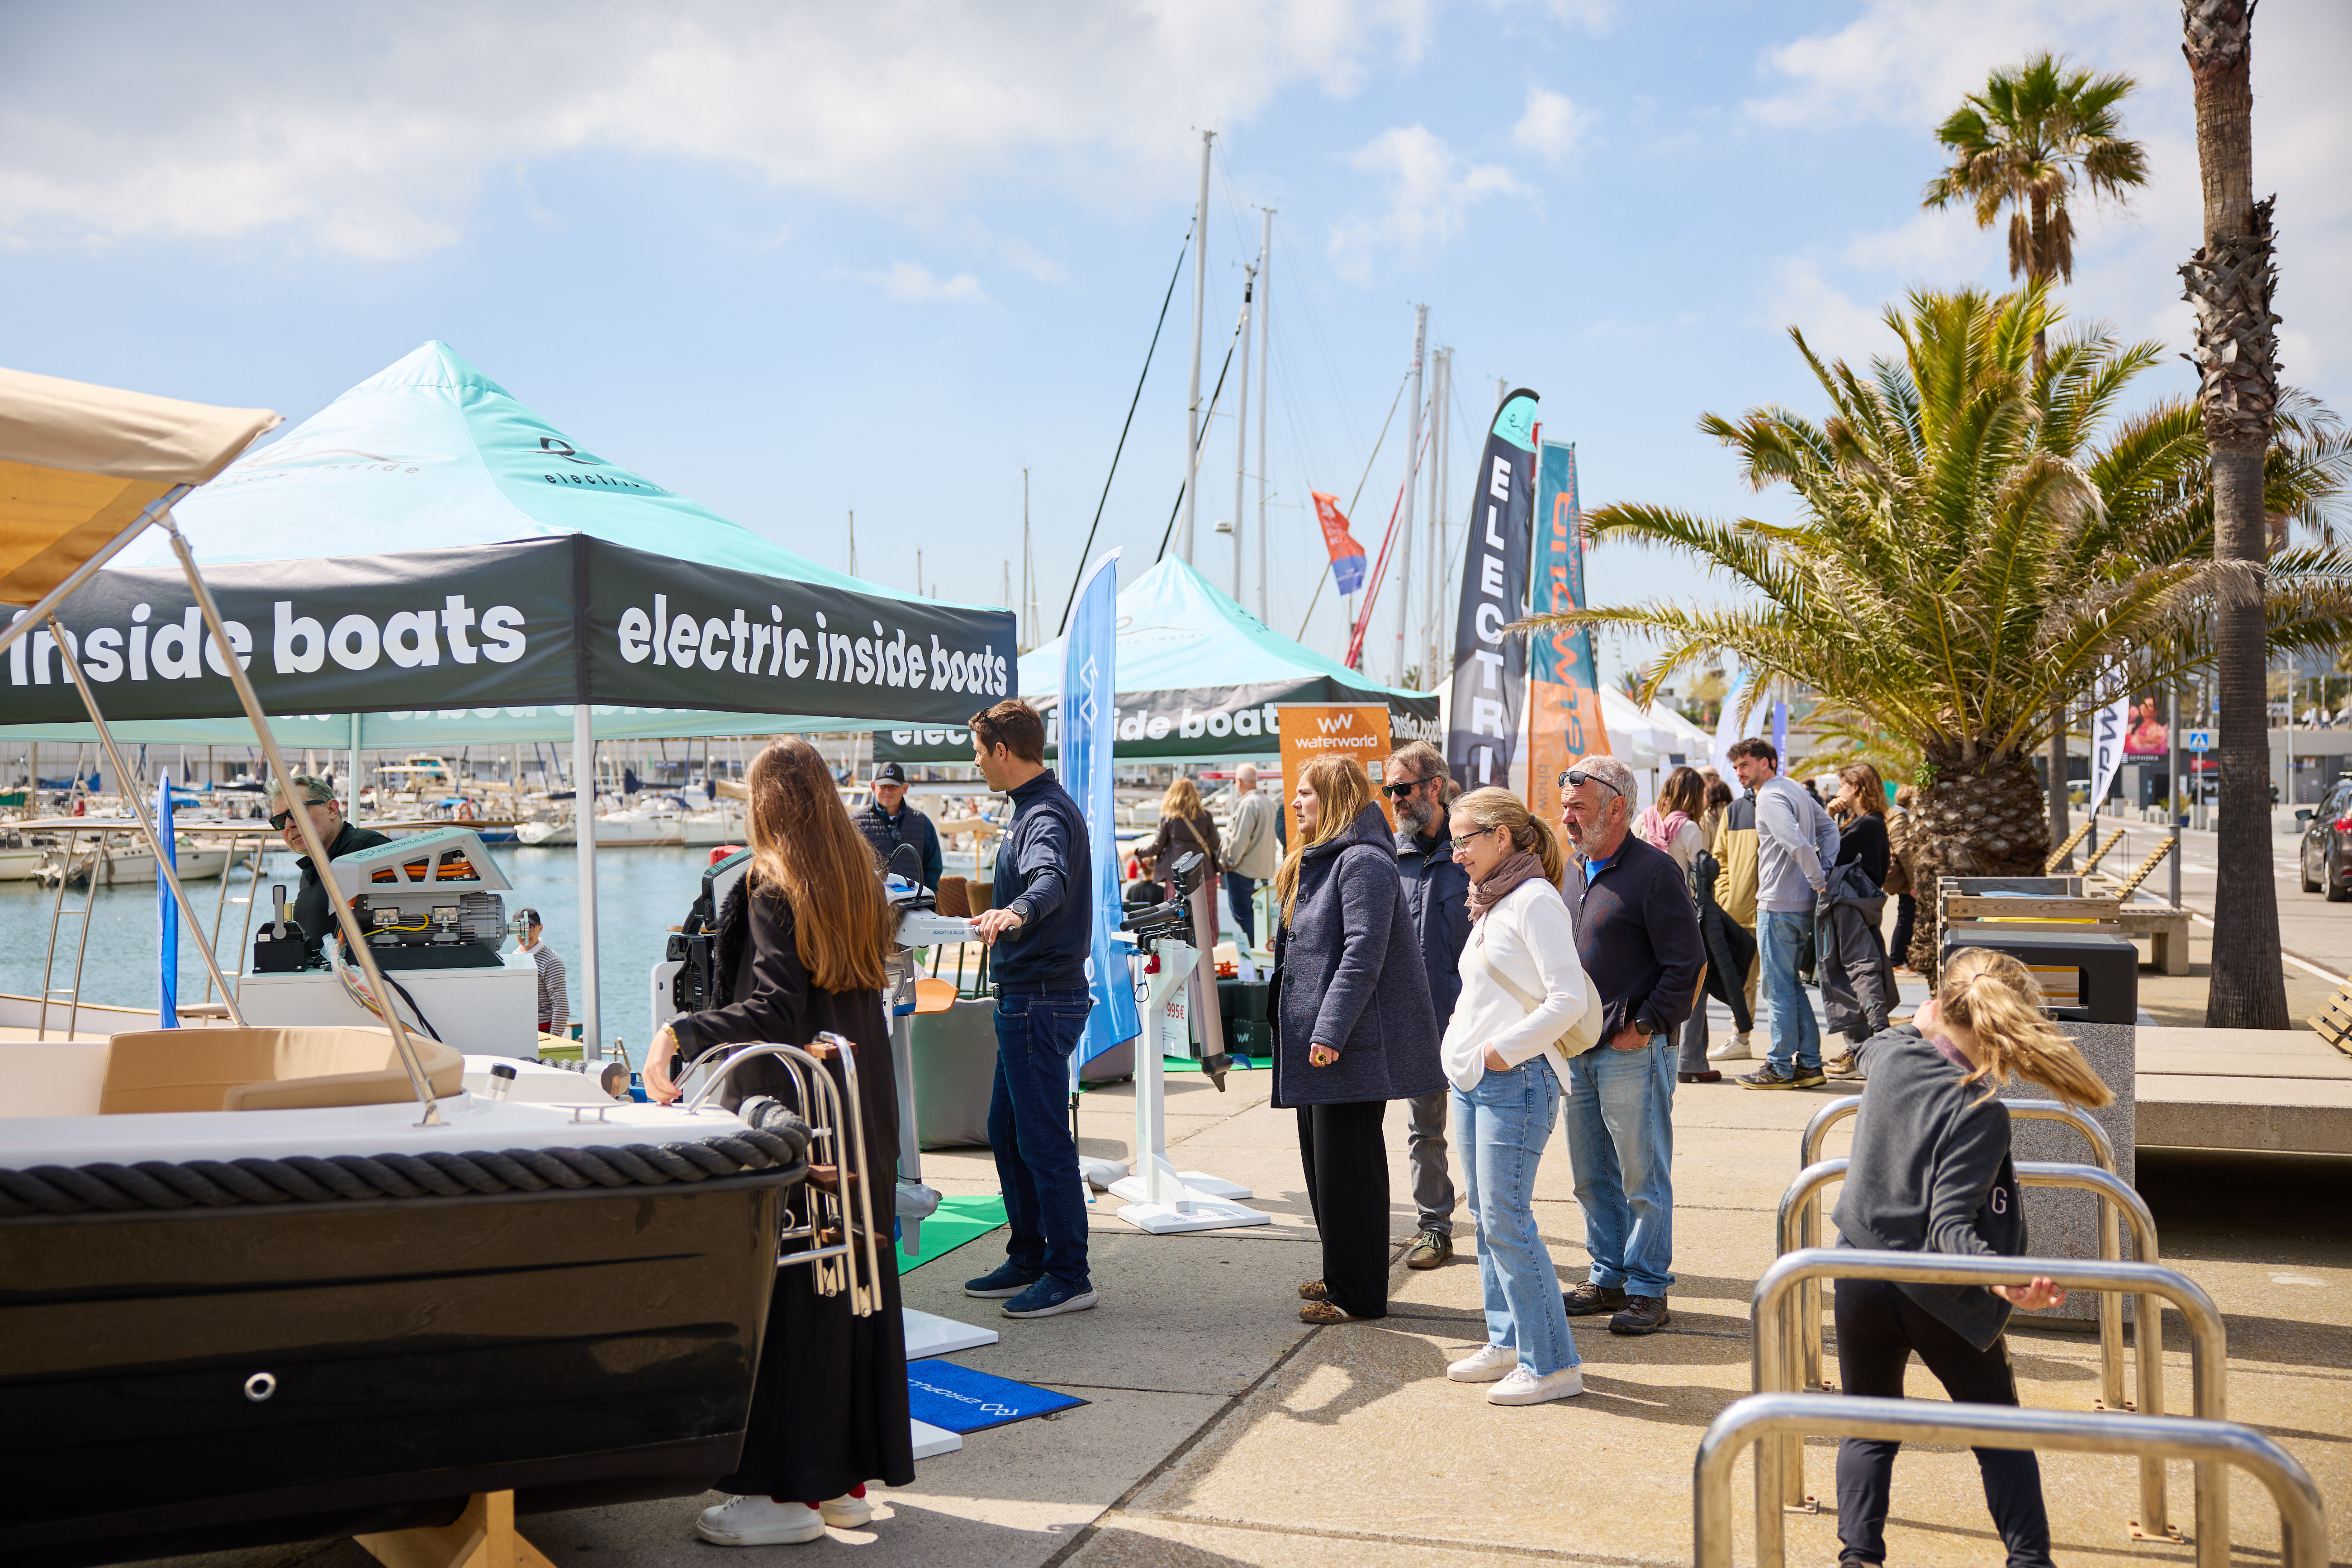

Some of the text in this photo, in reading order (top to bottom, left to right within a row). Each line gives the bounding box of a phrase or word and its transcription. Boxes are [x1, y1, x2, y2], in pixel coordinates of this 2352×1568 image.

[1471, 455, 1511, 785] ELECTRI
[10, 595, 526, 686] inside boats
[618, 593, 1007, 696] electric inside boats
[1180, 702, 1280, 739] boat
[1295, 734, 1378, 748] waterworld
[377, 832, 444, 853] EPROPULSION
[1167, 1002, 1184, 1020] 995€
